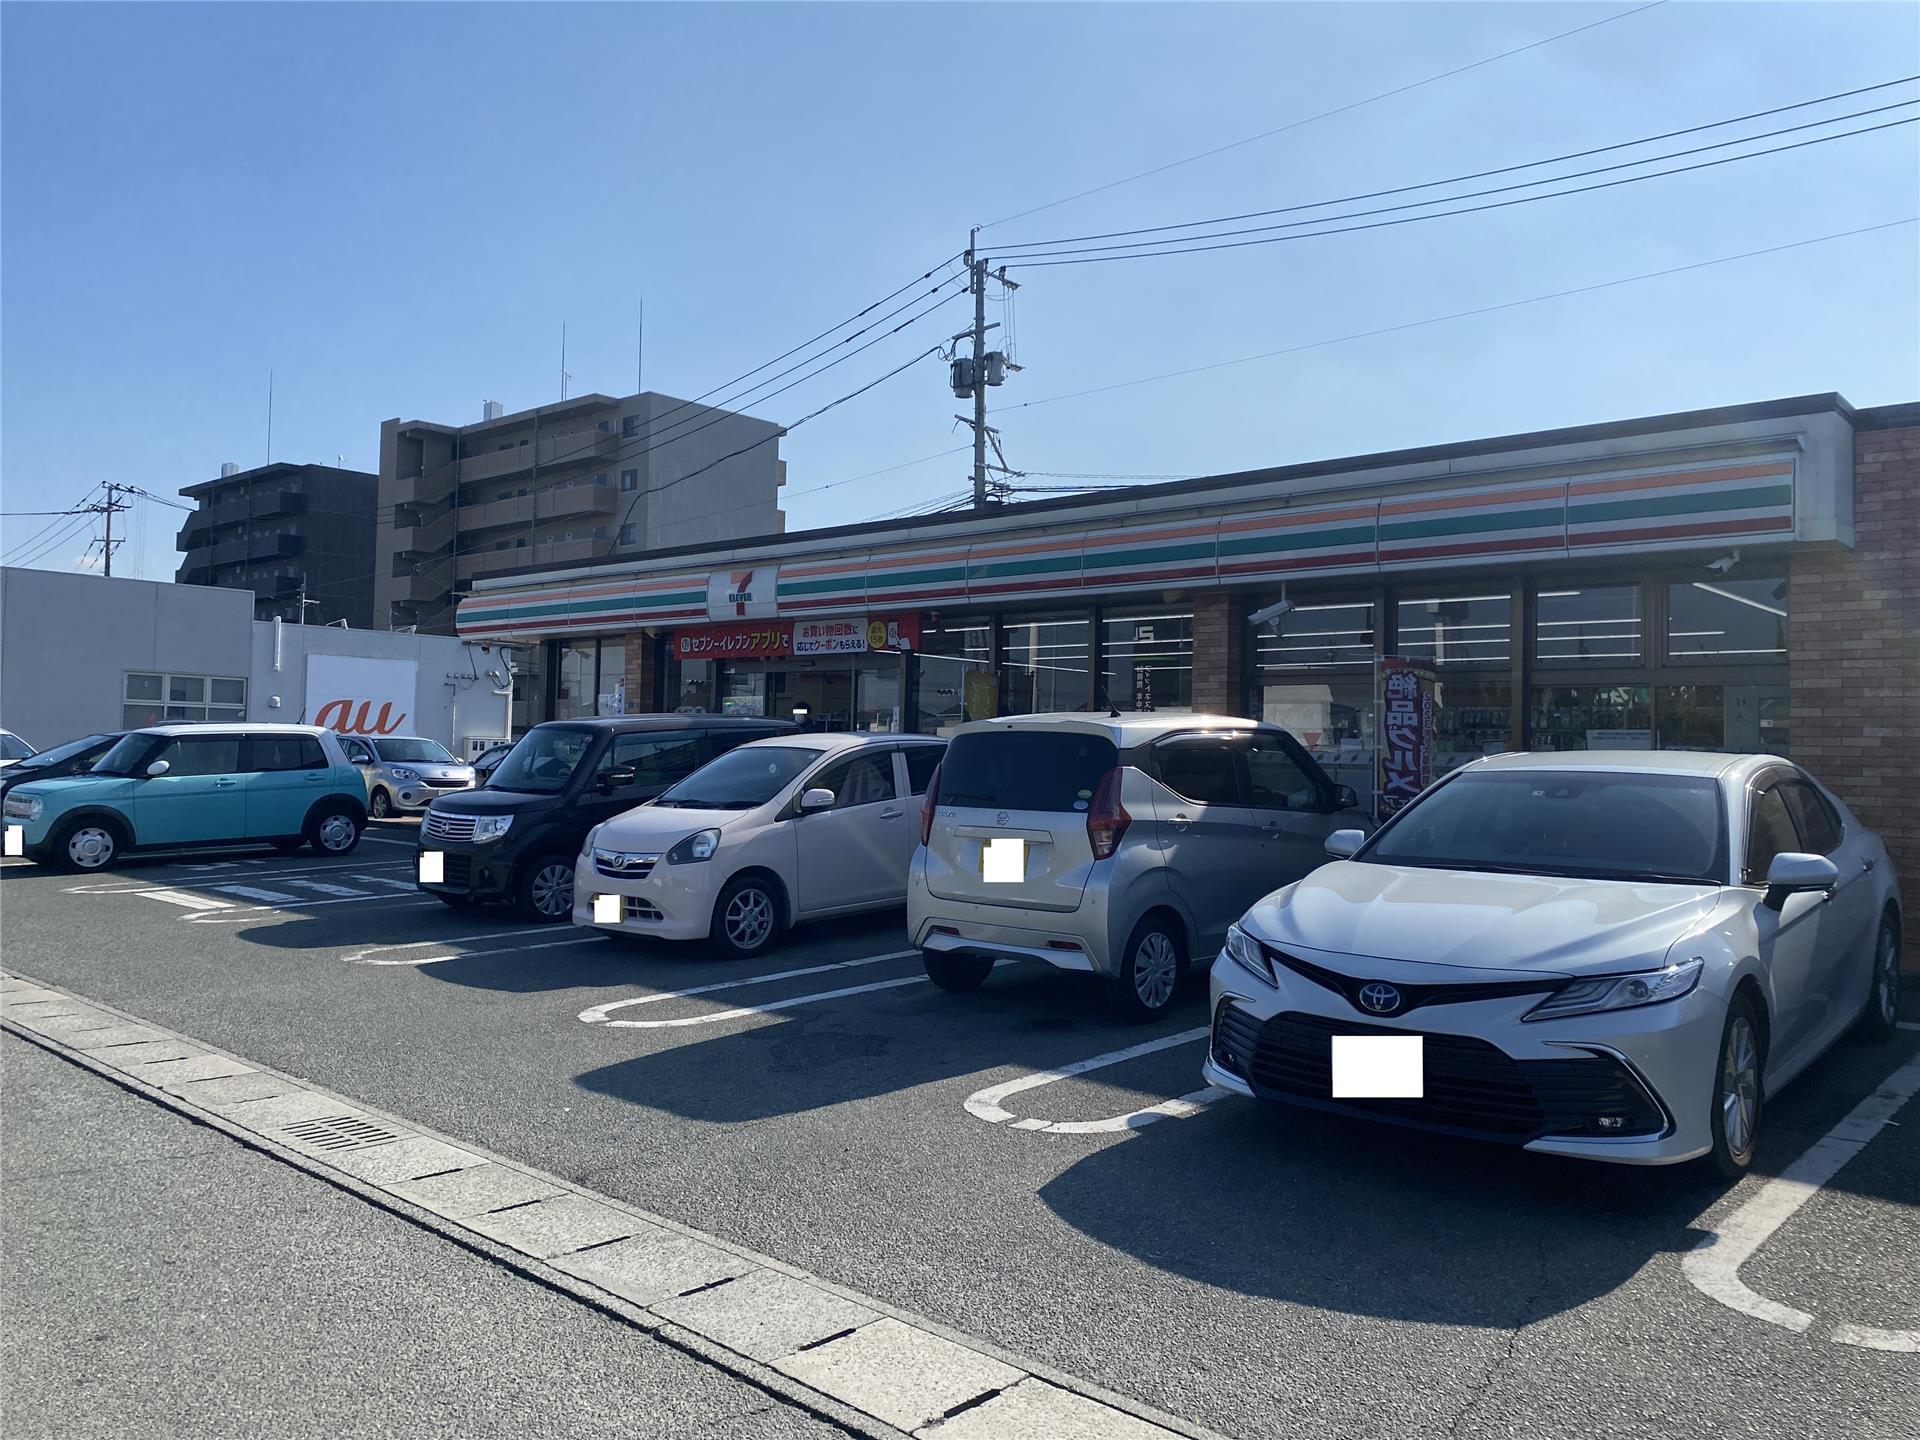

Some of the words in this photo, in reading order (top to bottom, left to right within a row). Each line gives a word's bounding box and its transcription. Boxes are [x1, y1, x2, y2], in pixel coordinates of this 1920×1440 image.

[730, 570, 753, 616] 7
[802, 622, 859, 638] お買い物回数に
[314, 699, 406, 735] au
